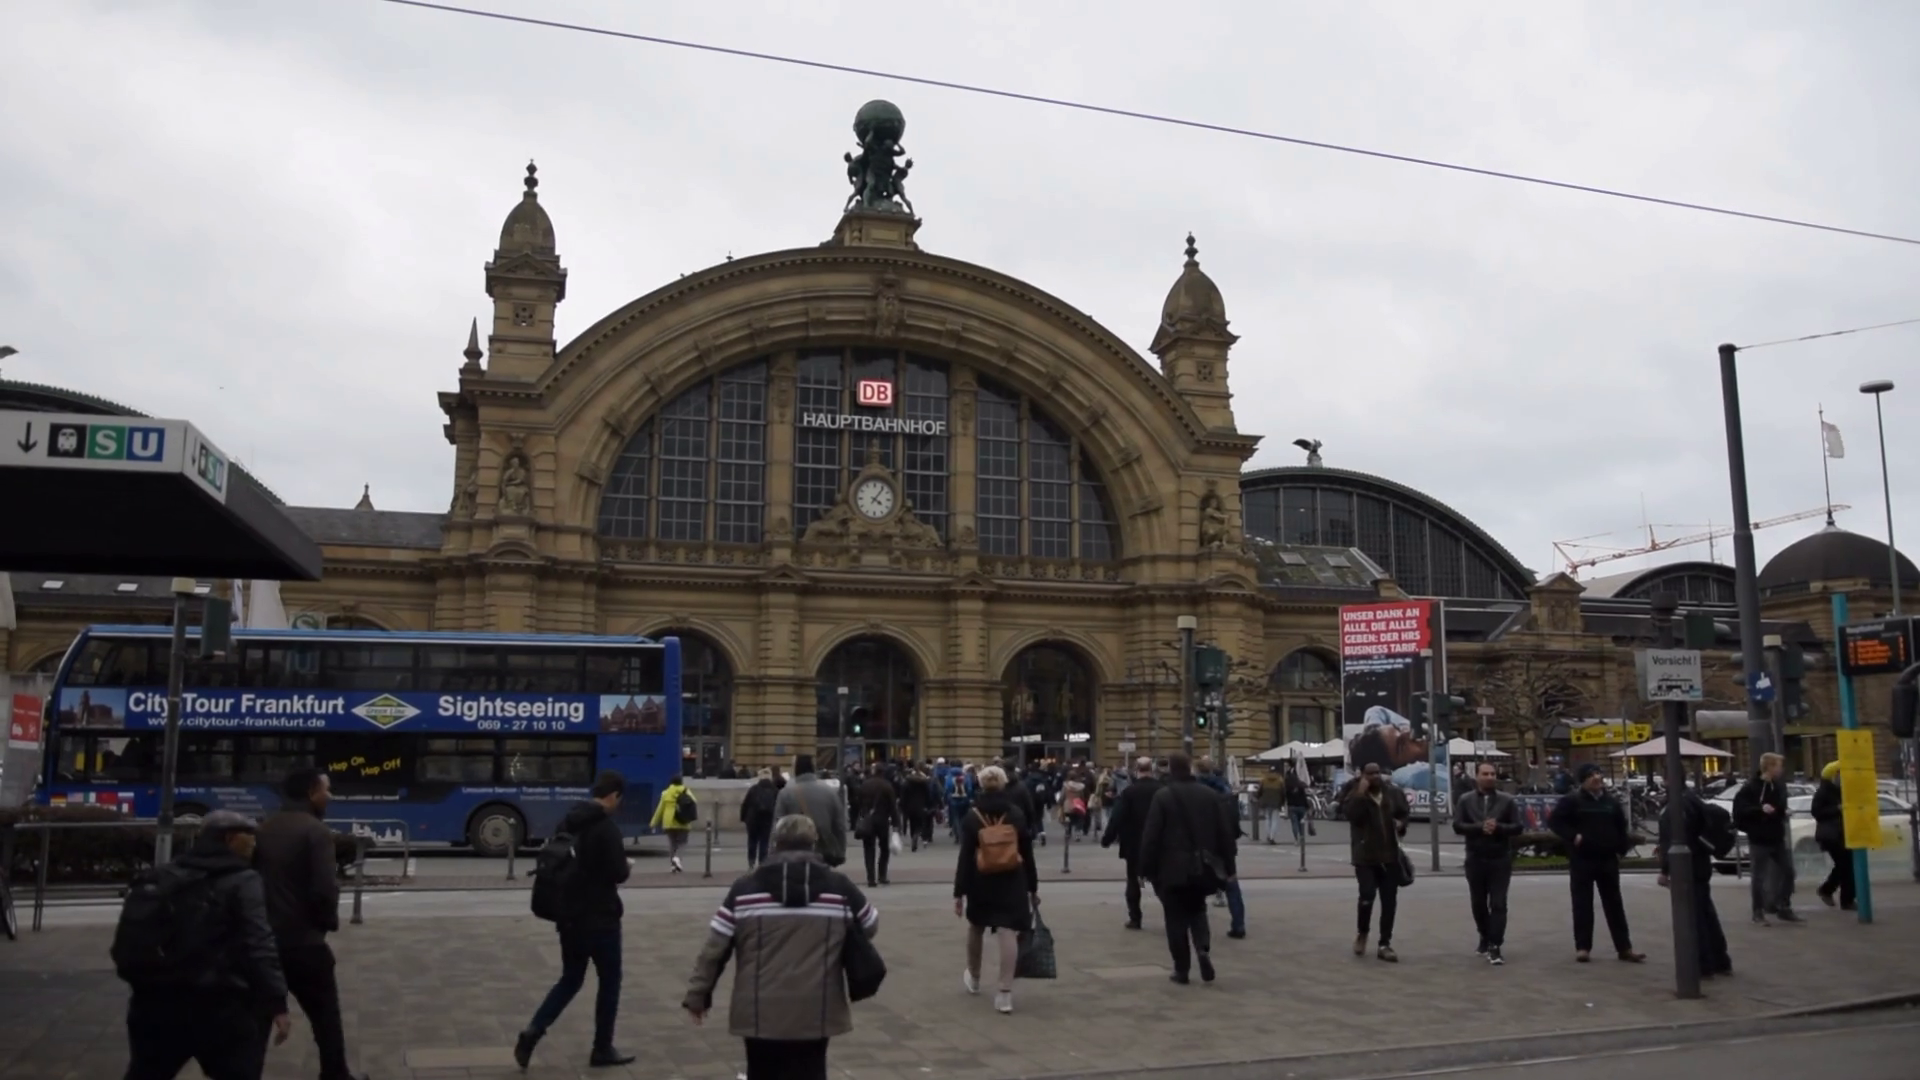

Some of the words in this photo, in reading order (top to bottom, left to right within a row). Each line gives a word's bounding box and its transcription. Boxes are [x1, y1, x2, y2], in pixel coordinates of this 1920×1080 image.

[862, 383, 889, 401] DB
[803, 412, 946, 435] HAUPTBAHNHOF
[94, 429, 118, 454] S
[131, 431, 160, 457] U
[1343, 611, 1374, 621] UNSER
[1376, 609, 1403, 620] DANK
[1405, 608, 1420, 618] AN
[1344, 622, 1370, 633] ALLE,
[1371, 621, 1387, 631] DIE
[1389, 619, 1417, 630] ALLES
[1380, 632, 1399, 642] DER
[1401, 631, 1421, 641] HRS
[1344, 645, 1388, 655] BUSINESS
[1390, 642, 1419, 653] TARIF.
[129, 692, 169, 717] City
[182, 693, 235, 713] Tour
[241, 693, 345, 715] Frankfurt
[438, 695, 585, 722] Sightseeing
[478, 720, 500, 730] 069
[512, 721, 527, 730] 27
[532, 721, 547, 730] 10
[551, 721, 566, 731] 10
